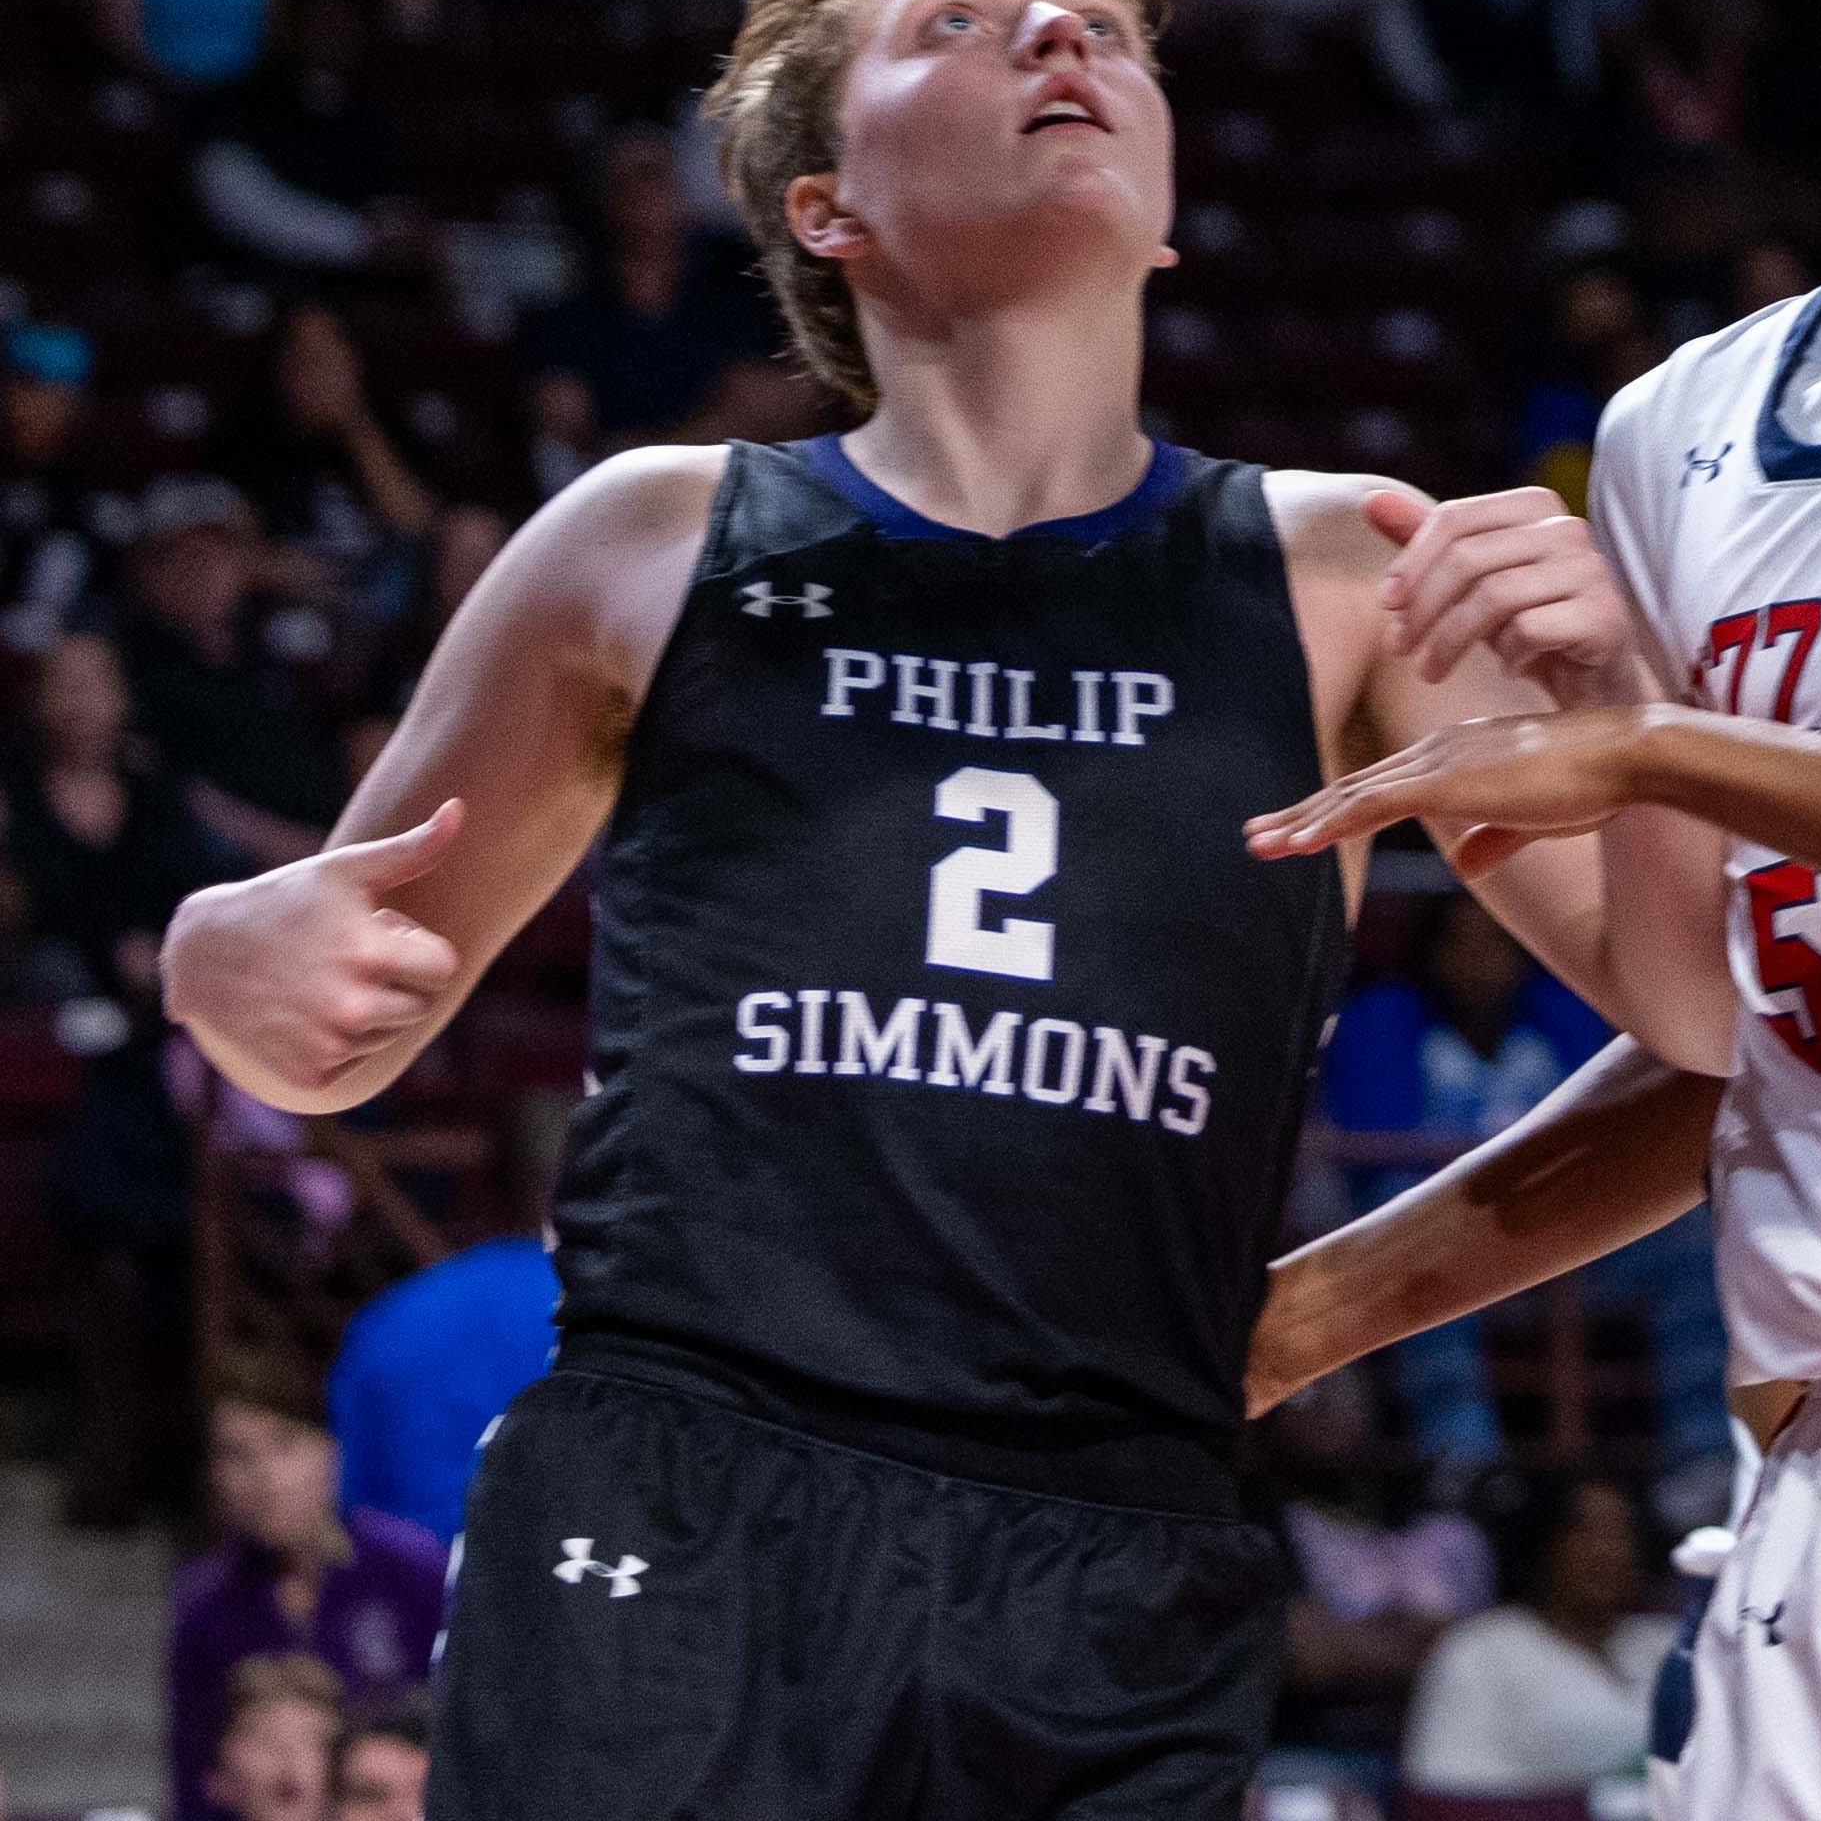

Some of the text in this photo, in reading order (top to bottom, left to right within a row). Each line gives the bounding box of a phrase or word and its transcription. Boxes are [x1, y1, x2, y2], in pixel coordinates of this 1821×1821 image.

[820, 647, 1175, 746] PHILIP
[925, 765, 1059, 981] 2
[732, 989, 1217, 1136] SIMMONS
